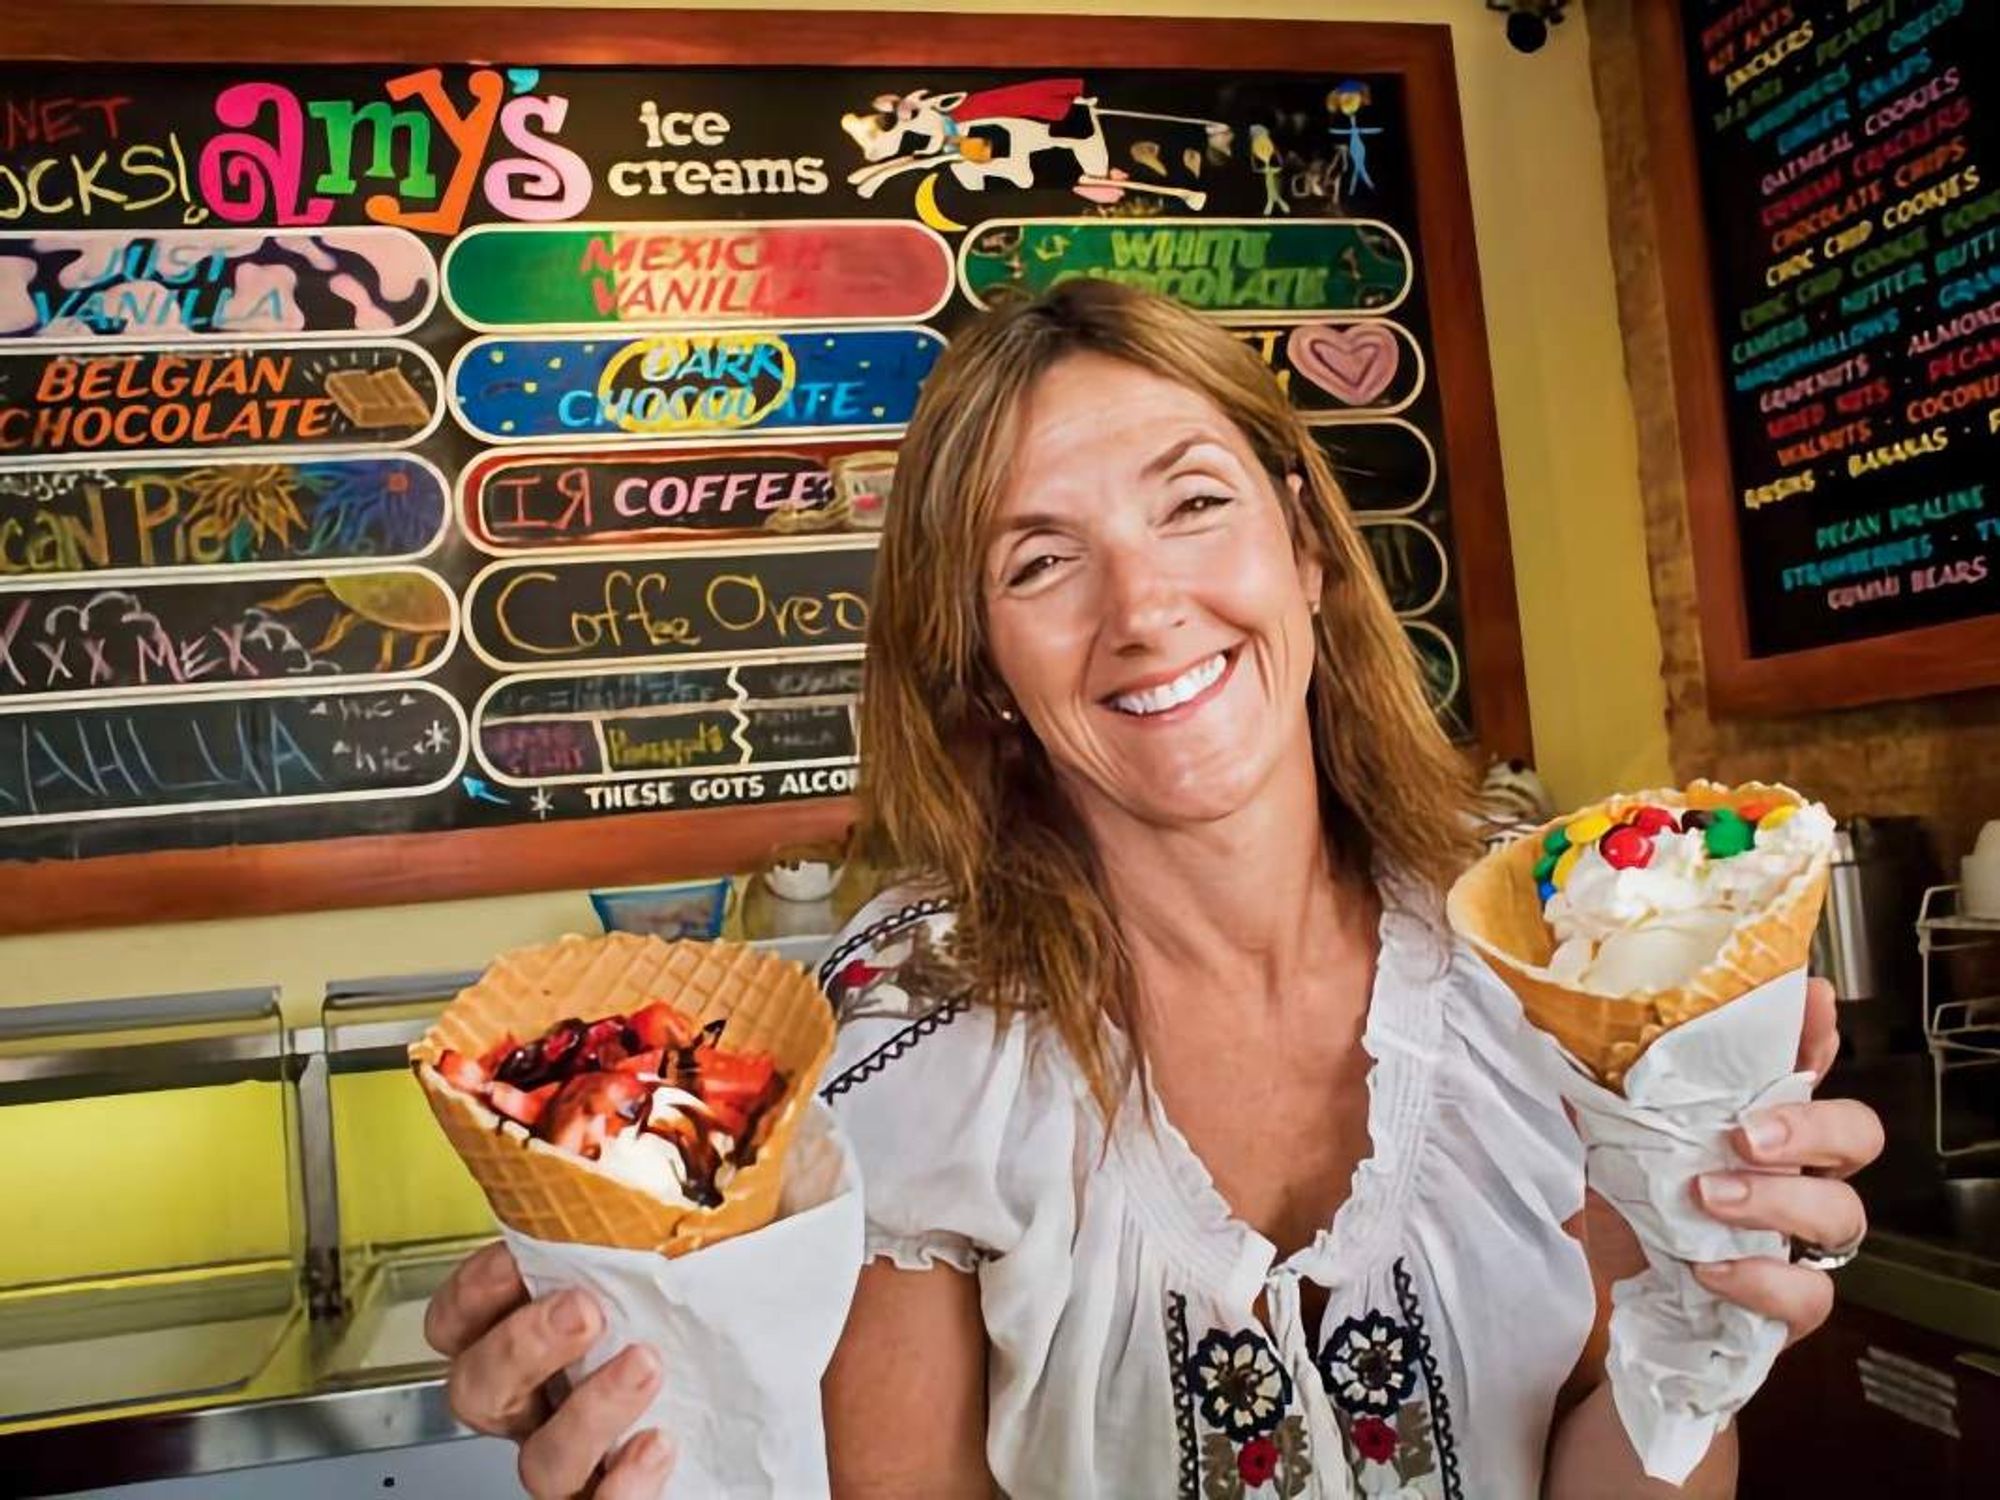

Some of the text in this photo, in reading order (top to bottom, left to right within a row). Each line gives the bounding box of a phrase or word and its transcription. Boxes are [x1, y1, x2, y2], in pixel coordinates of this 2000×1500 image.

[640, 101, 731, 148] ice
[1761, 66, 1960, 195] OATMEAL COOKIES
[607, 155, 829, 196] creams
[1883, 164, 1981, 229] COOKIES
[1771, 180, 1884, 252] CHOCOLATE
[34, 284, 284, 333] VANILLA
[36, 356, 293, 403] BELGIAN
[641, 343, 785, 383] DARK
[0, 398, 333, 448] CHOCOLATE
[557, 381, 865, 428] CHOCOLATE
[1847, 426, 1949, 478] BANANAS
[613, 471, 831, 517] COFFEE
[1815, 483, 1986, 551] PECAN PRALINE
[1911, 554, 1988, 593] BEARS
[585, 781, 674, 810] THESE
[690, 774, 765, 802] GOTS
